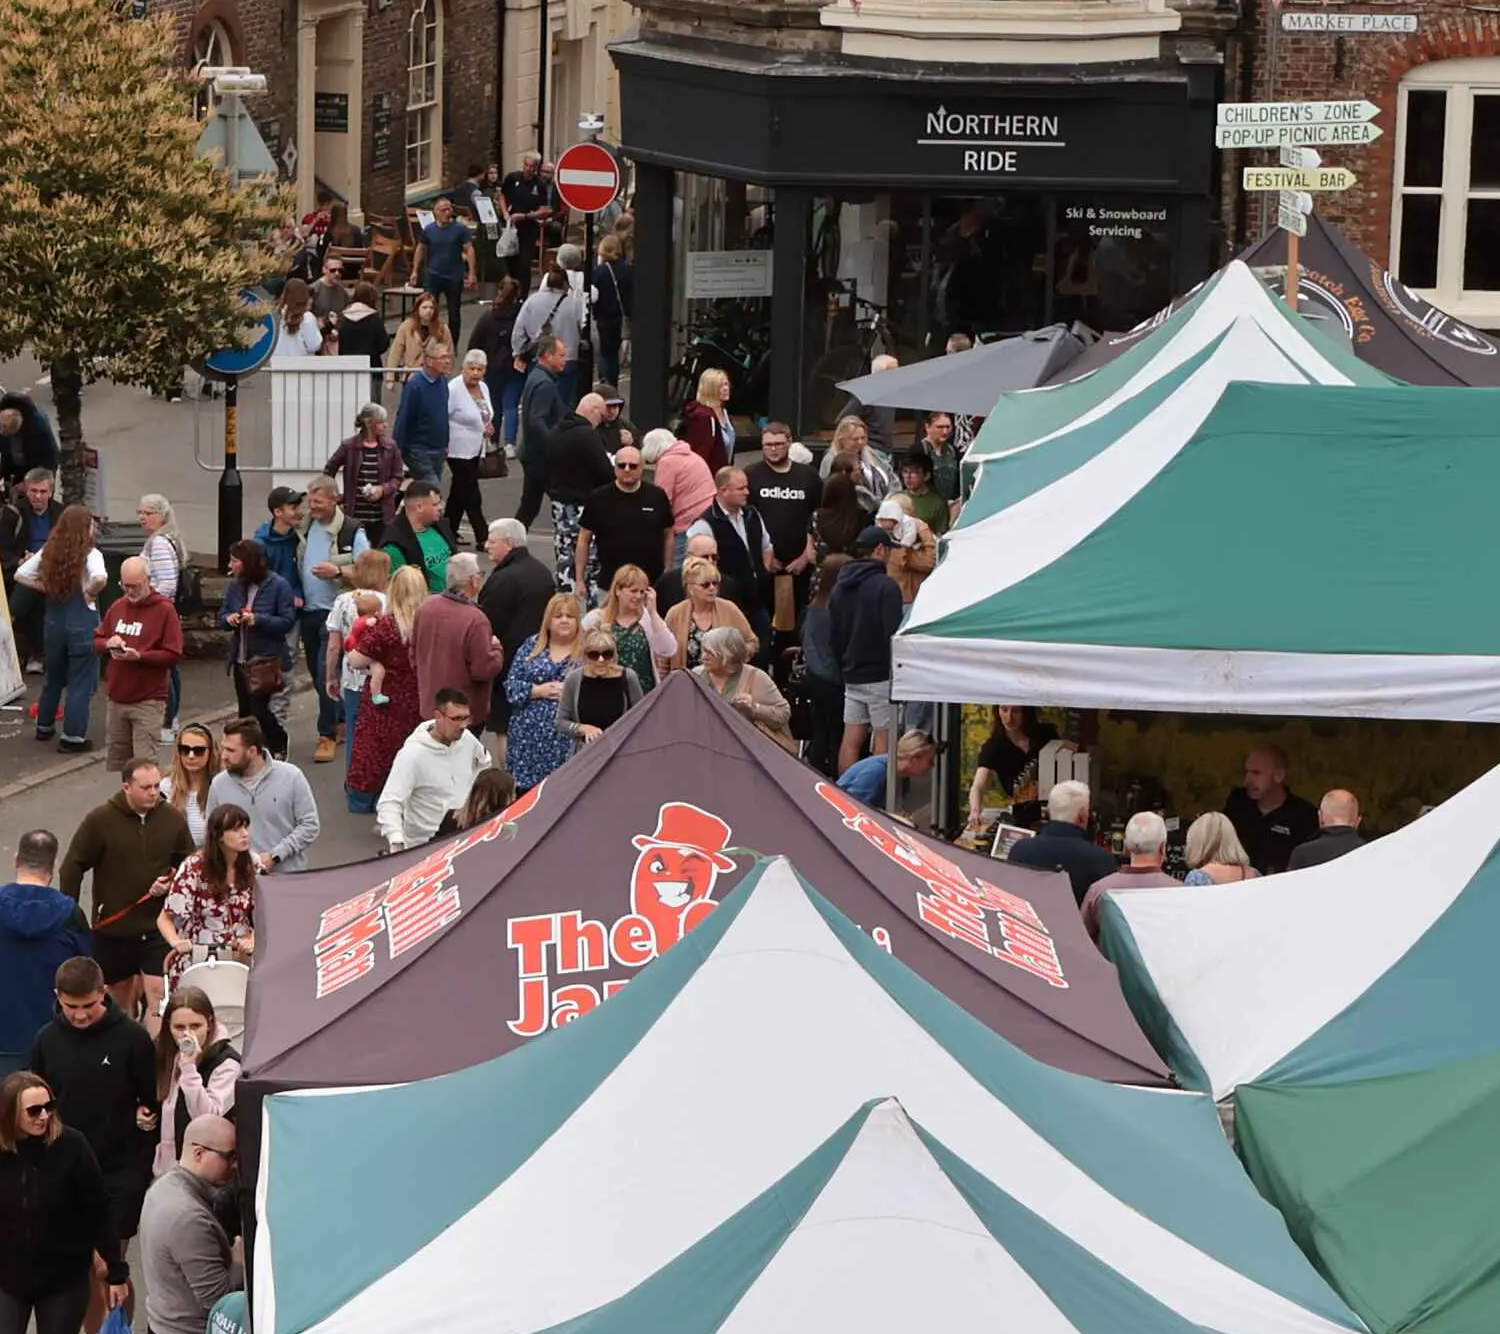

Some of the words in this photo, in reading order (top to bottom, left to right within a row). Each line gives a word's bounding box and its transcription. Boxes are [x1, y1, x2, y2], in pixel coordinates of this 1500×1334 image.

[1288, 16, 1354, 29] MARKET
[1362, 17, 1412, 29] PLACE
[1225, 106, 1313, 123] CHILDREN'S
[1324, 104, 1361, 121] ZONE
[927, 111, 1058, 136] NORTHERN
[1279, 127, 1327, 143] PICNIC
[1332, 125, 1369, 140] AREA
[964, 151, 1016, 171] RIDE
[1247, 173, 1309, 187] FESTIVAL
[1320, 173, 1345, 187] BAR
[1065, 207, 1083, 219] Ski
[1086, 208, 1096, 219] &
[1099, 208, 1166, 220] Snowboard
[1089, 225, 1142, 239] Servicing
[760, 487, 805, 500] adidas
[507, 910, 658, 978] The
[992, 911, 1069, 988] Jam
[506, 975, 629, 1036] Ja
